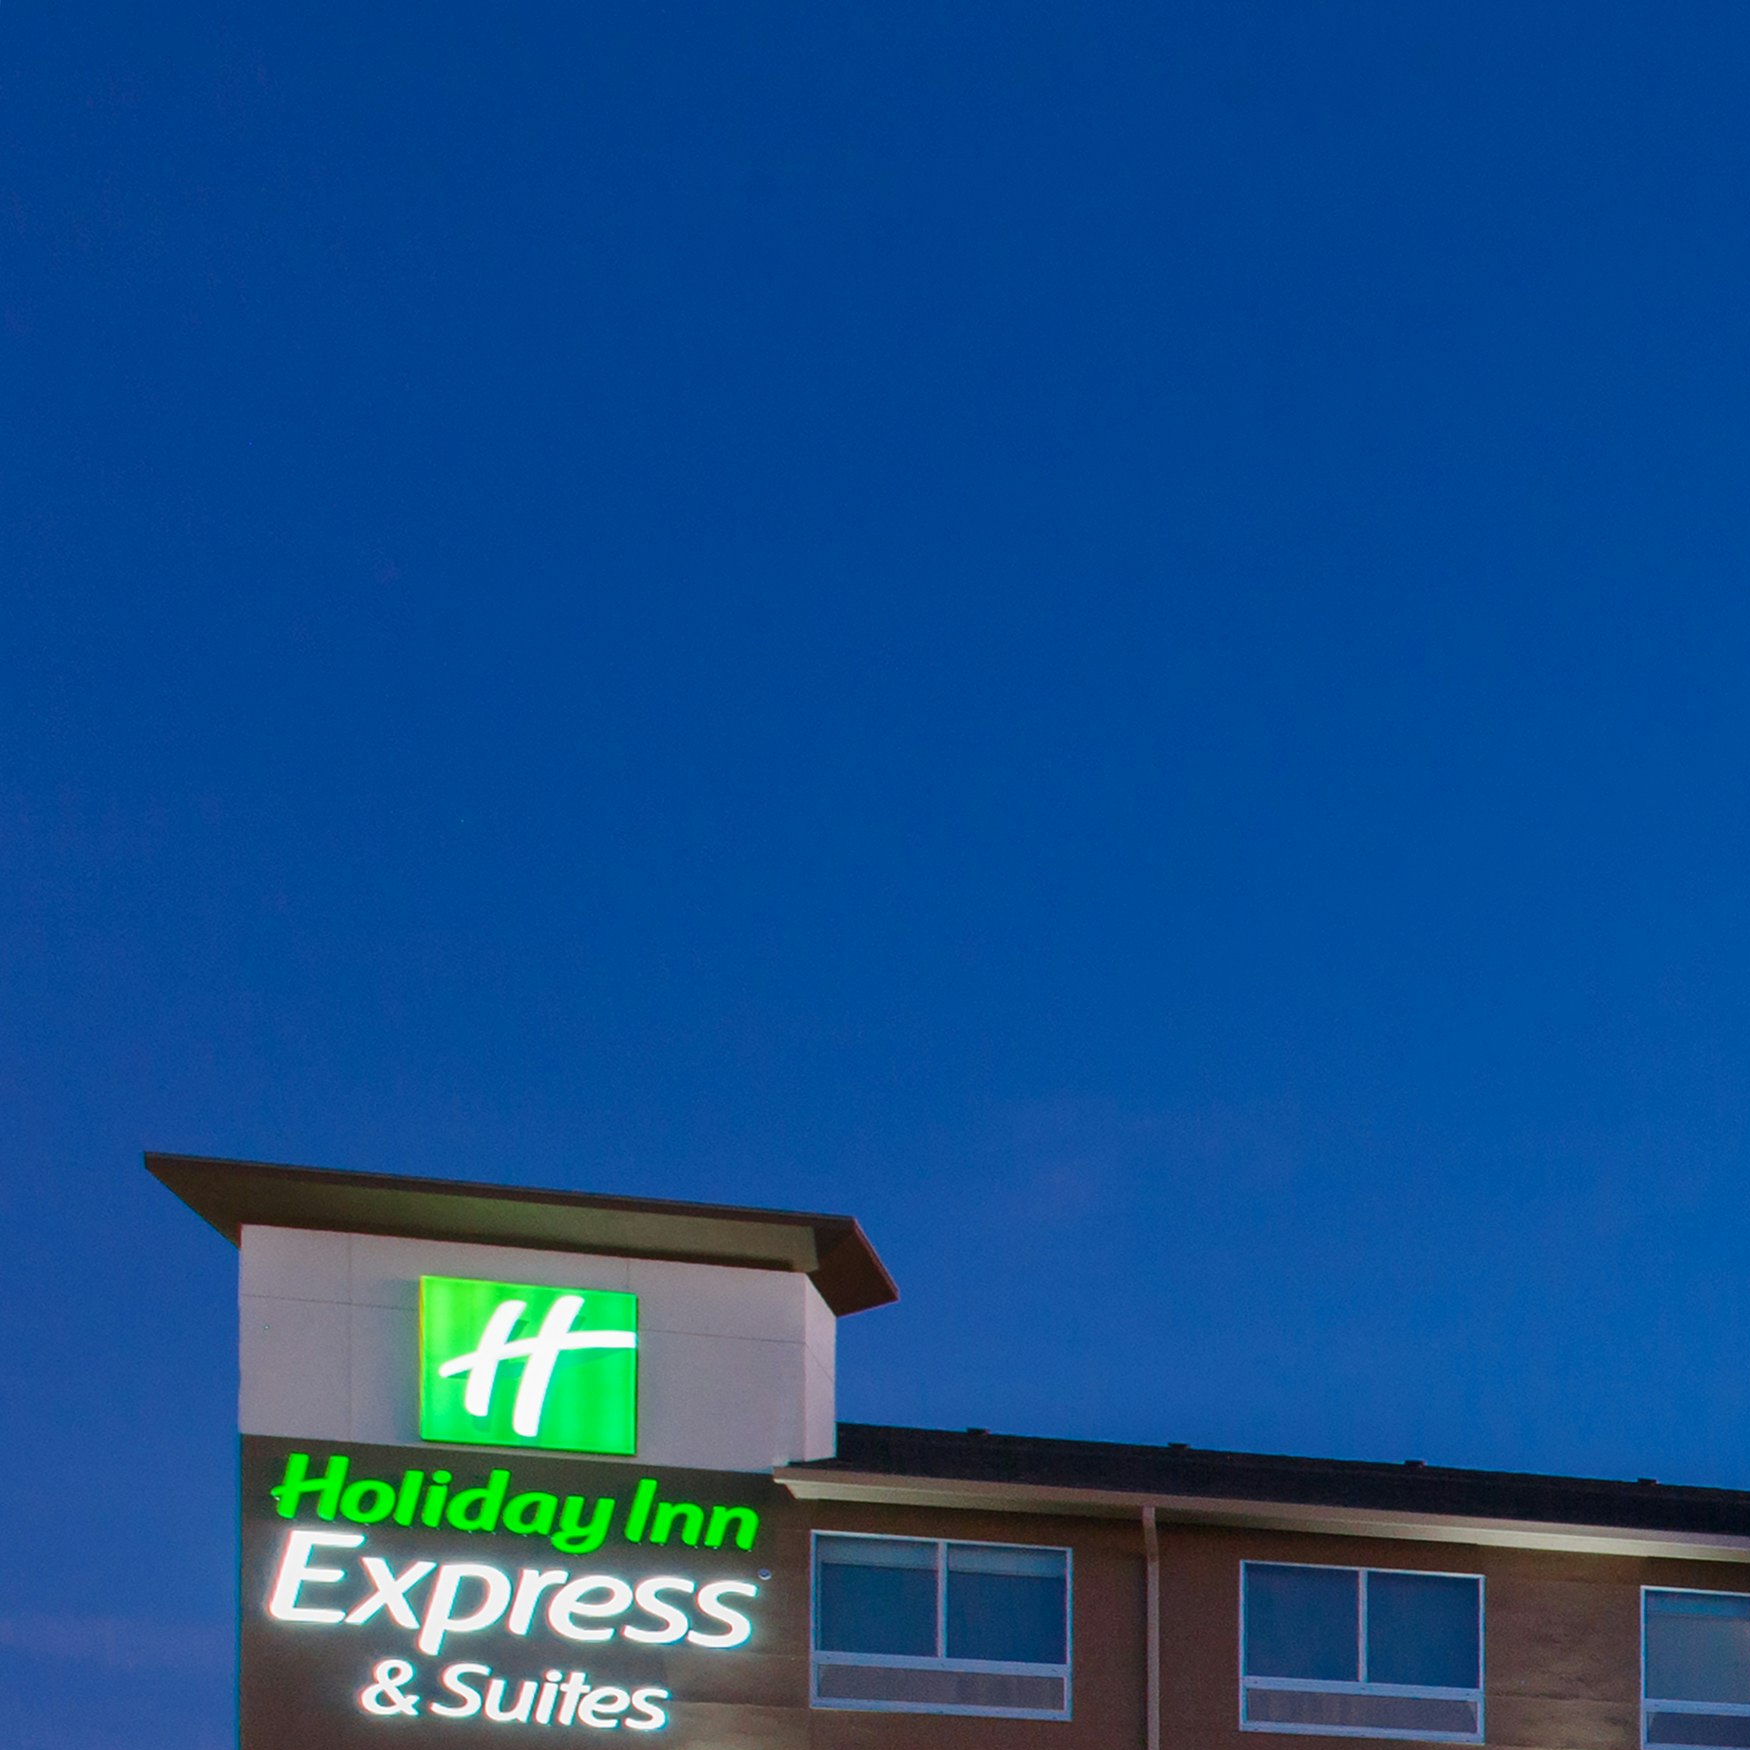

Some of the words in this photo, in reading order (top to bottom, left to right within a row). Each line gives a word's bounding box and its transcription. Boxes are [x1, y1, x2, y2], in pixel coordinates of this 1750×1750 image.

[270, 1452, 616, 1556] Holiday
[624, 1478, 760, 1552] Inn
[268, 1529, 758, 1656] Express
[360, 1658, 419, 1717] &
[430, 1662, 669, 1730] Suites
